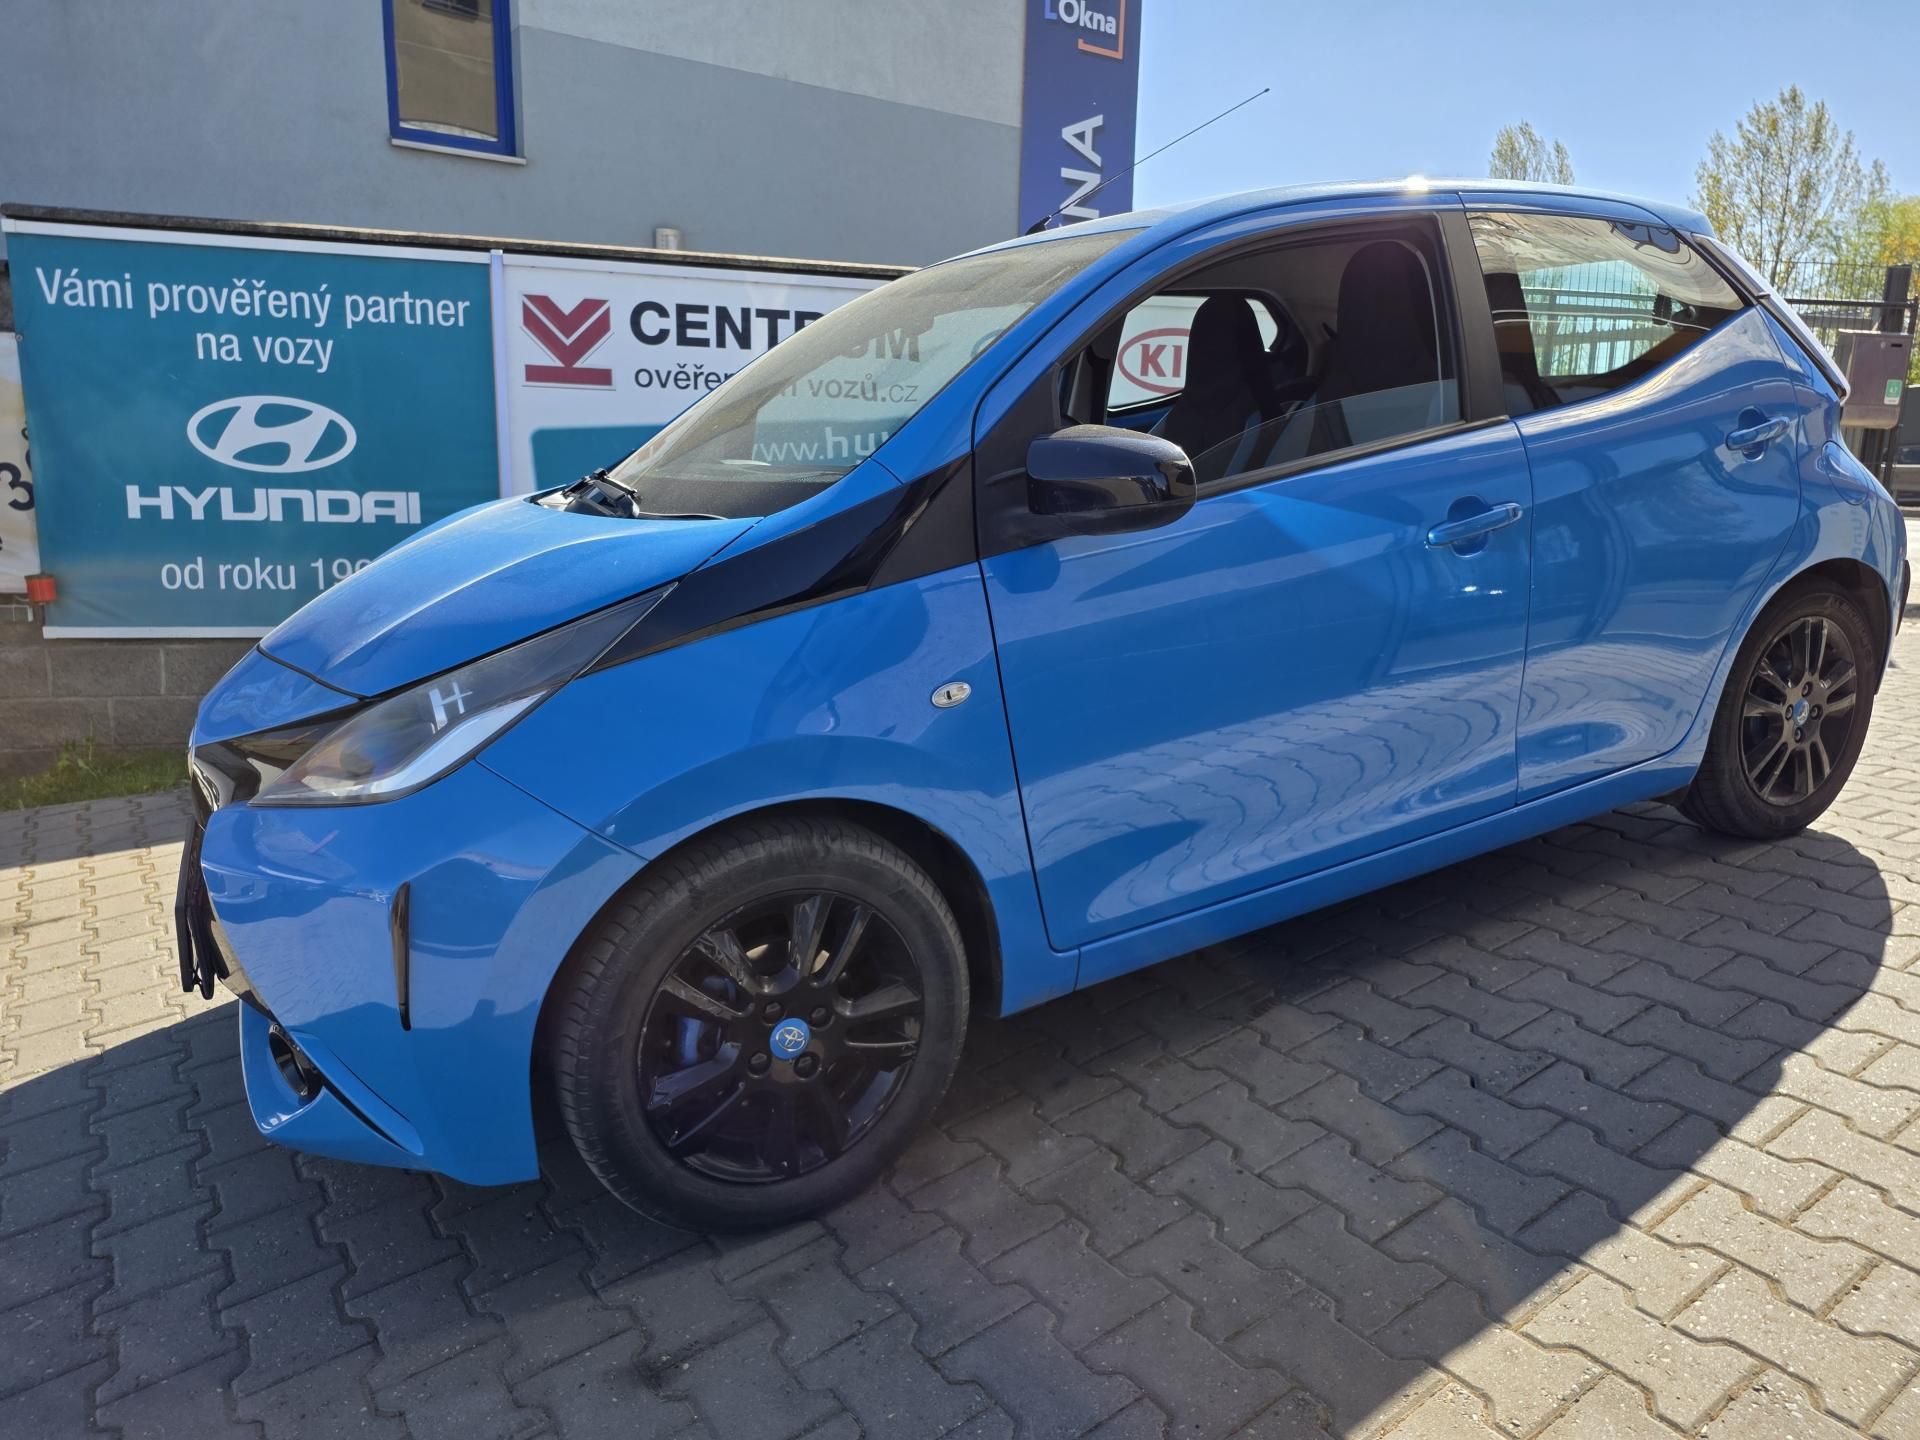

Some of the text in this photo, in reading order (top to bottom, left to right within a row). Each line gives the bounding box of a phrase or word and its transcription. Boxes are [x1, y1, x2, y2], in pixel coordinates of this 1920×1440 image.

[1058, 0, 1117, 35] Okna
[1059, 114, 1103, 228] NA
[36, 267, 471, 328] Vámi prověřený partner
[196, 332, 334, 373] na vozy
[807, 373, 919, 404] vozů.cz
[126, 484, 422, 525] HYUNDAI
[161, 556, 204, 590] od
[219, 556, 297, 591] roku
